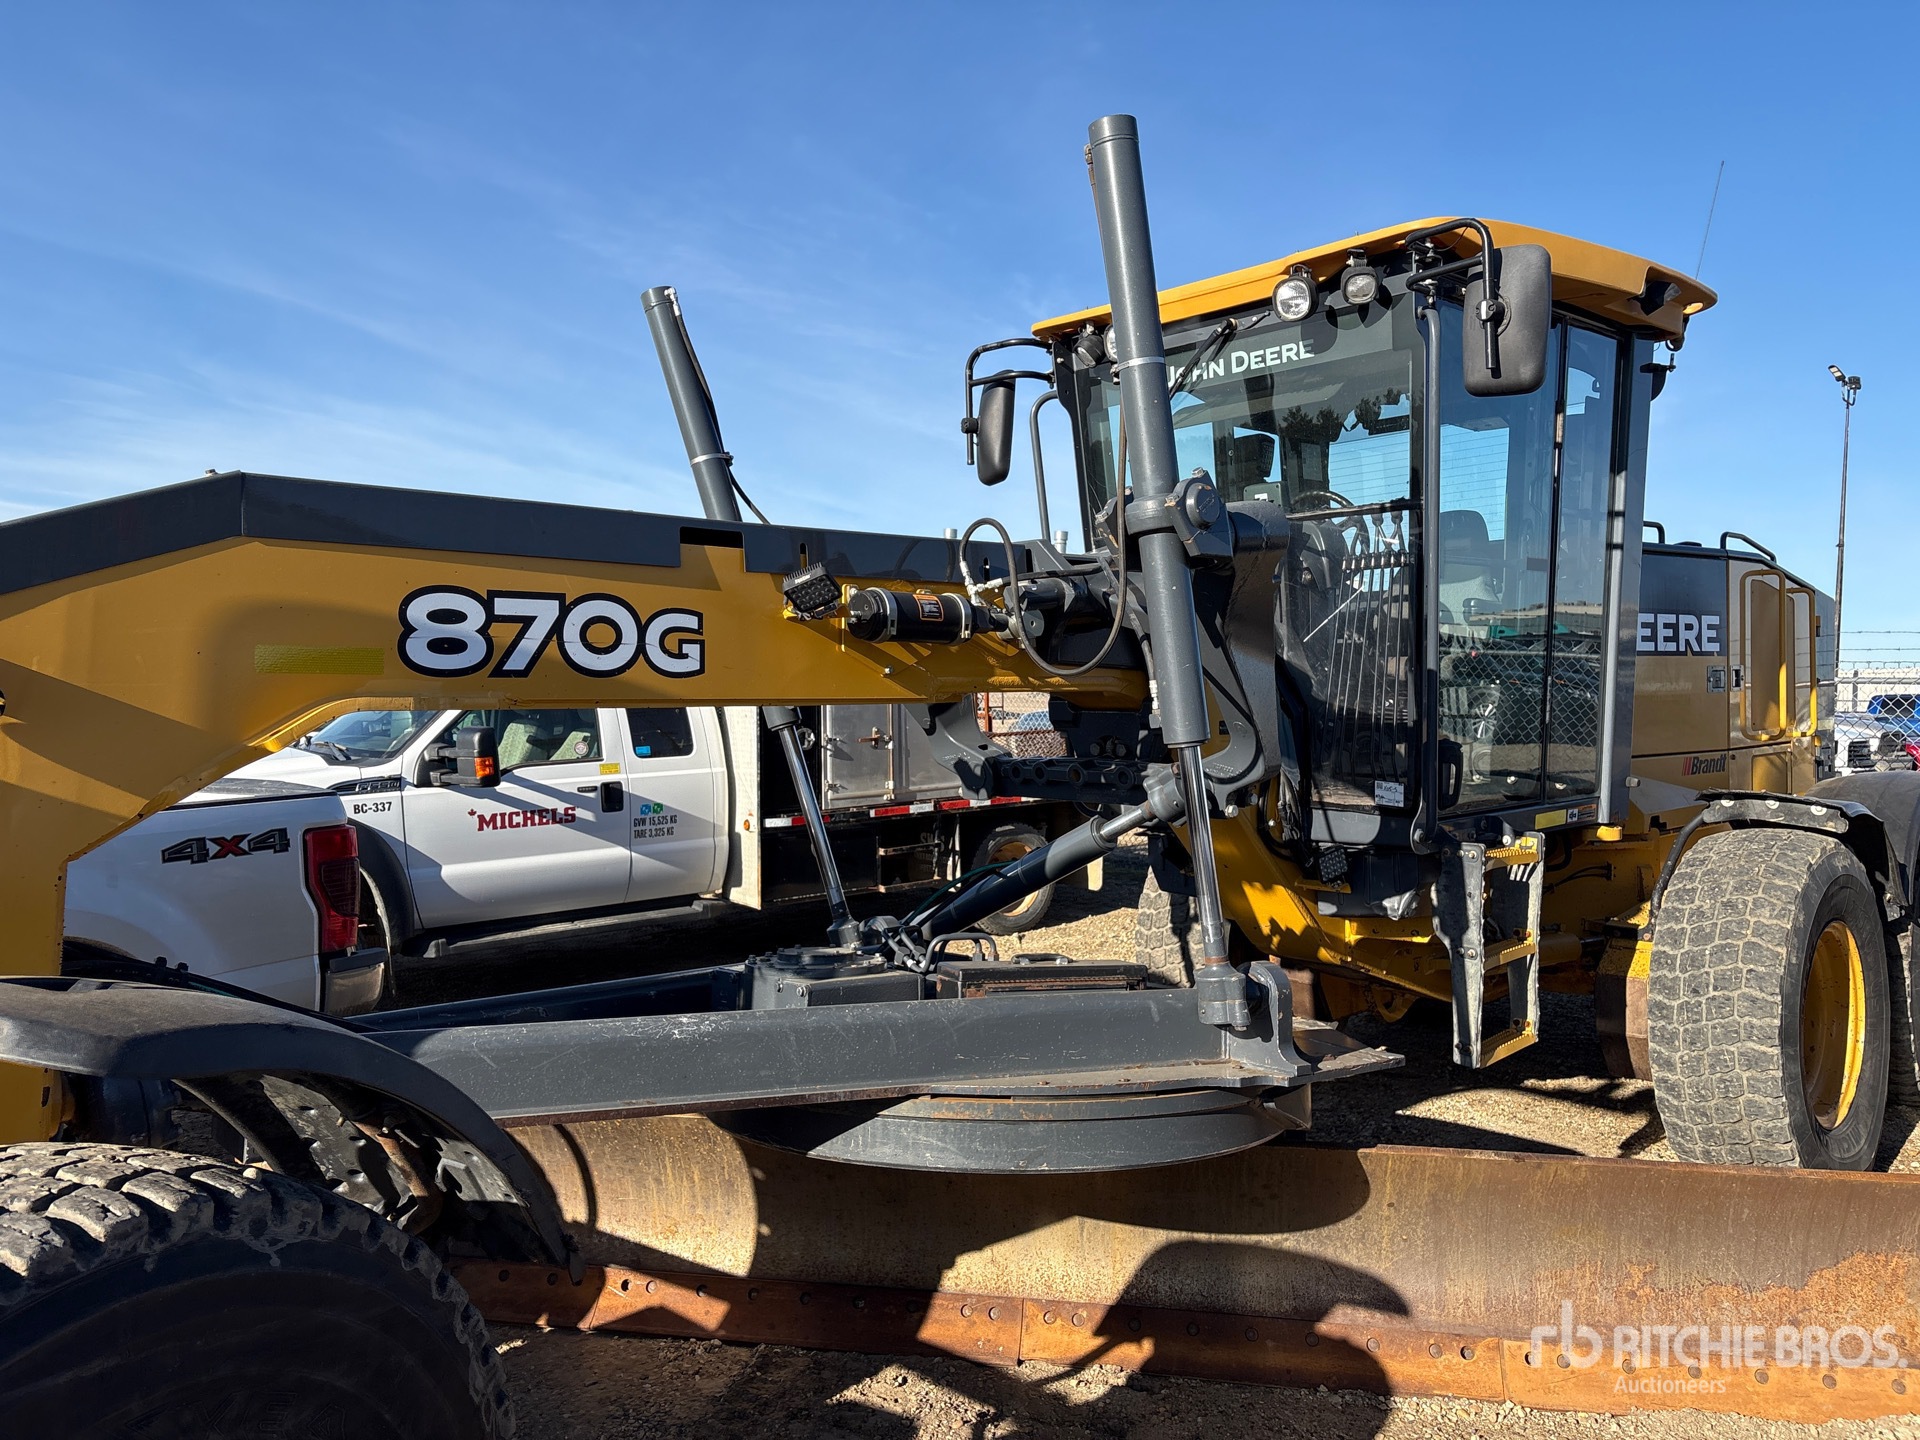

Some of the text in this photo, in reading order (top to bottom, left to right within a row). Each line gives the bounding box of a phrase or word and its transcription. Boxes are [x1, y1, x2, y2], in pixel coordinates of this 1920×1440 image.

[1230, 339, 1315, 374] DEERE
[398, 585, 705, 678] 870G
[1691, 754, 1727, 776] Brandt
[353, 801, 392, 815] BC-337
[477, 806, 578, 832] MICHELS
[633, 814, 677, 827] GVW 15,525 KG
[633, 826, 674, 839] TARE 3,325 KG
